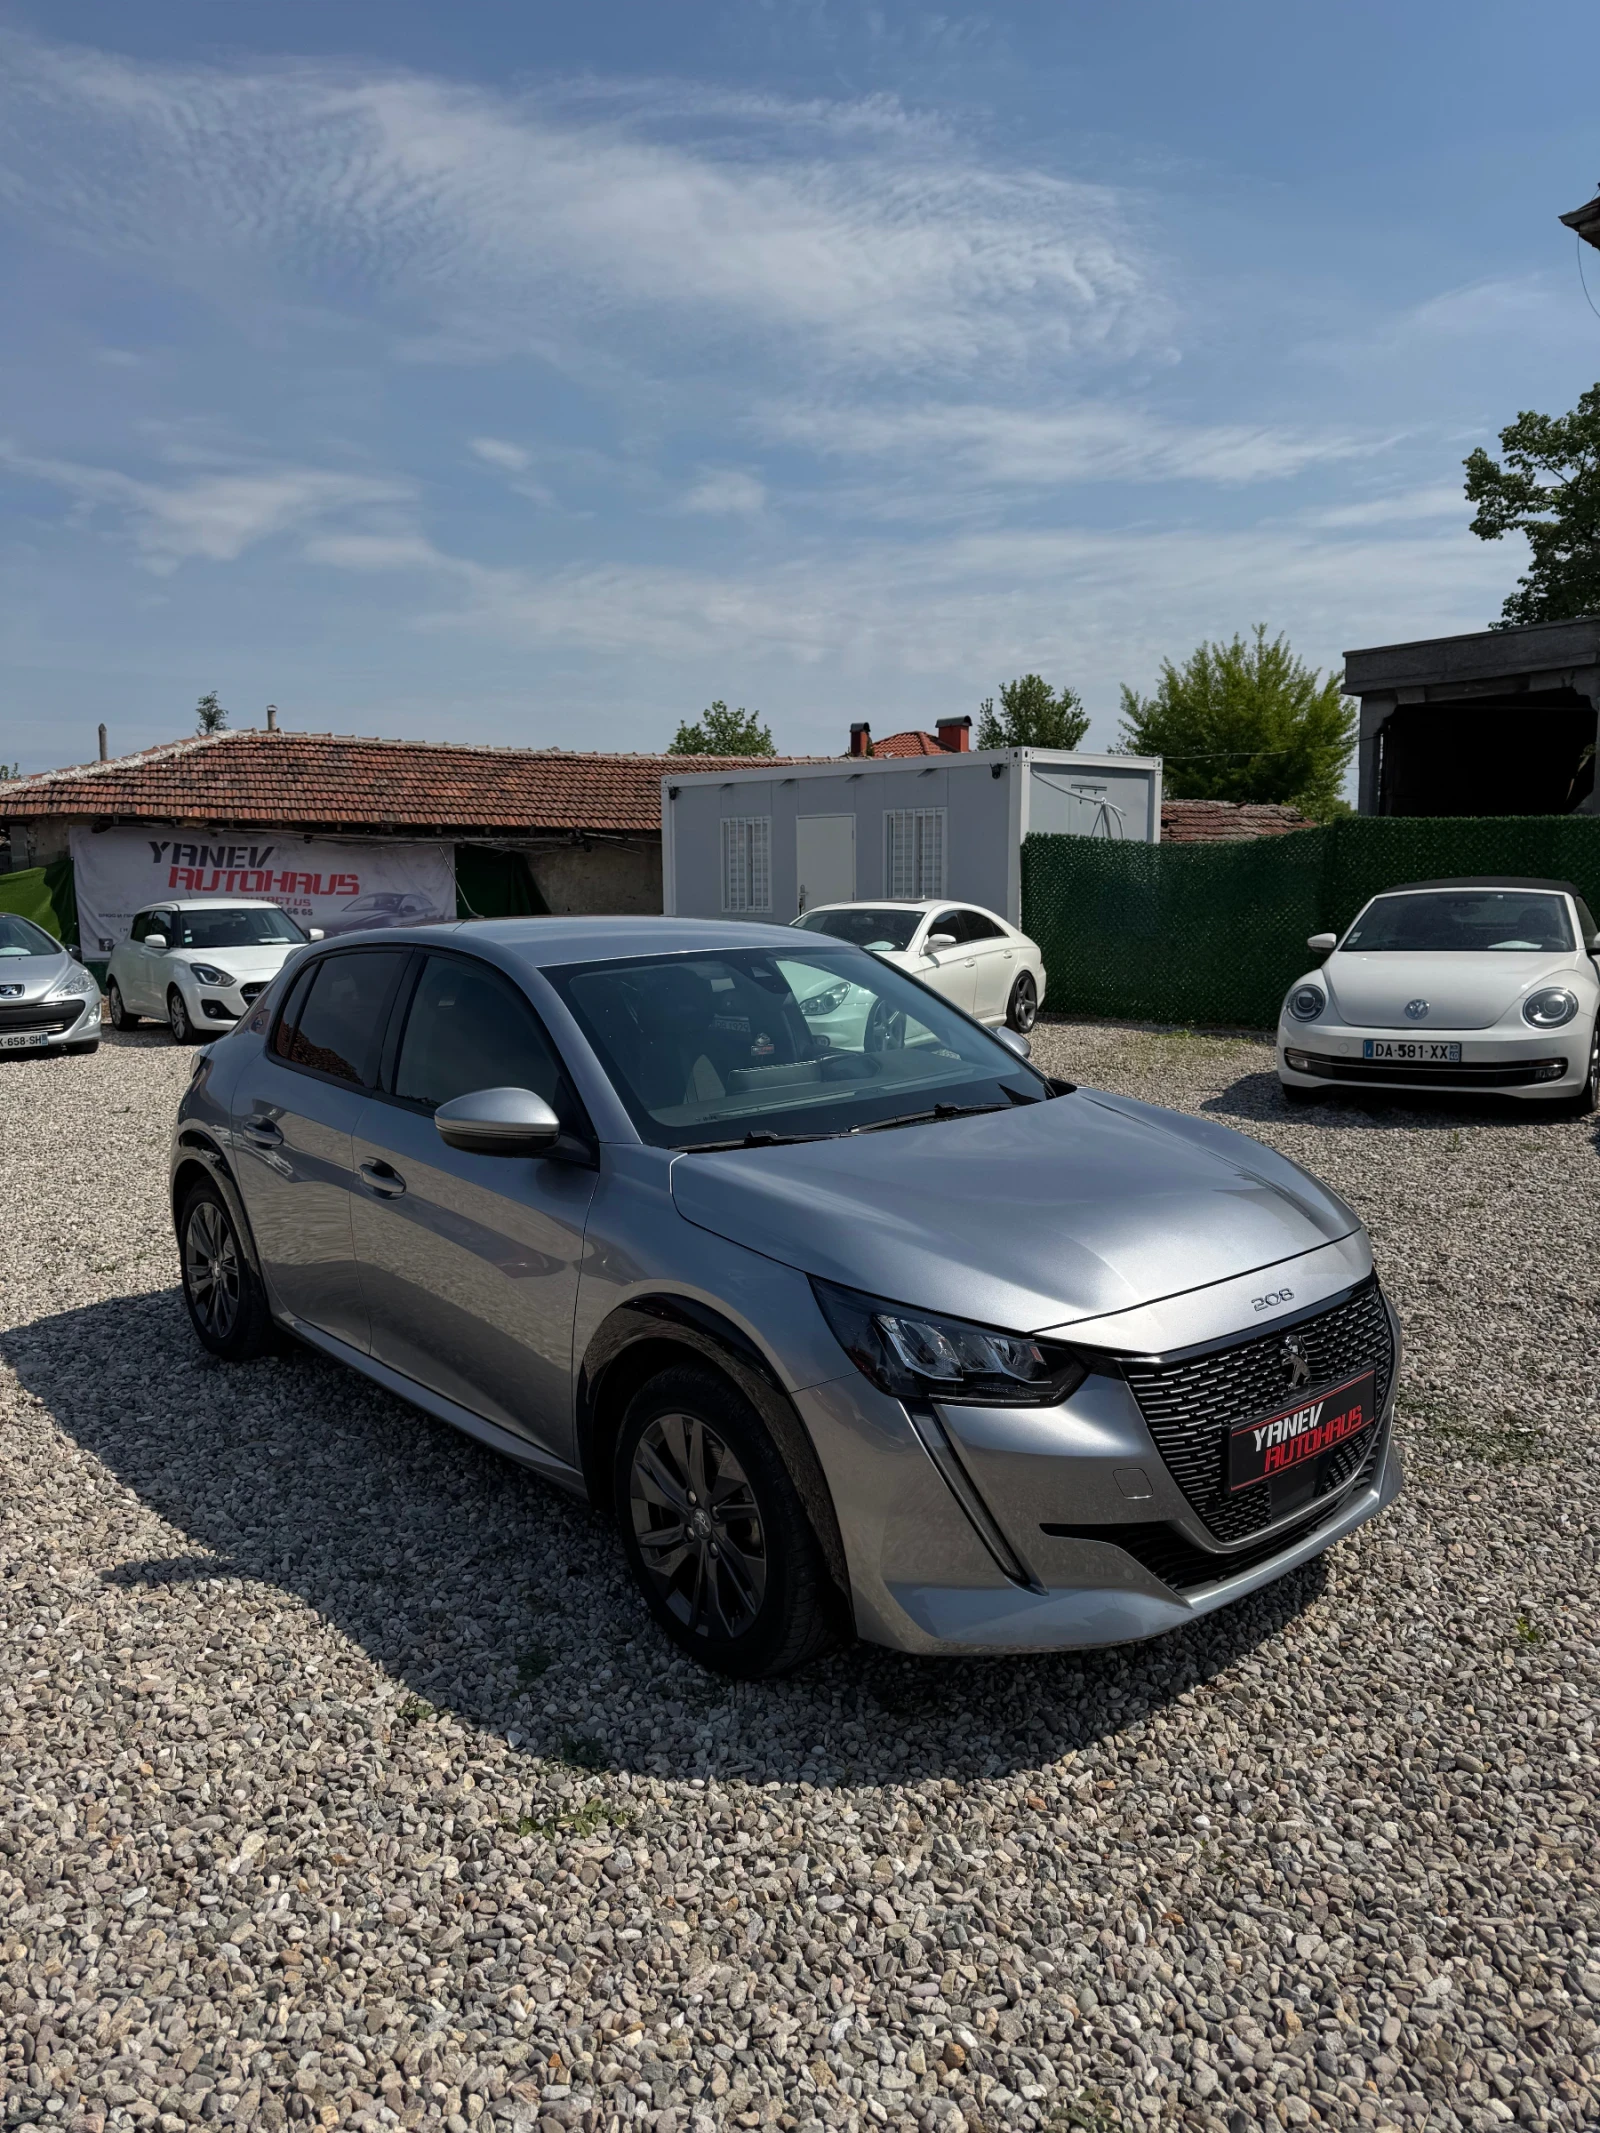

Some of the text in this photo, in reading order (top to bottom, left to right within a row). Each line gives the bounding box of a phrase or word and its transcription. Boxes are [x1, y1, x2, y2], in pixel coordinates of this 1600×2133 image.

[148, 841, 275, 869] YANEV
[168, 867, 360, 896] AUTOHAUS
[294, 898, 312, 907] US
[1375, 1043, 1448, 1059] DA-581-XX
[1251, 1288, 1295, 1311] 208
[1253, 1402, 1324, 1452] YANEV
[1264, 1405, 1362, 1473] AUTOHAUS
